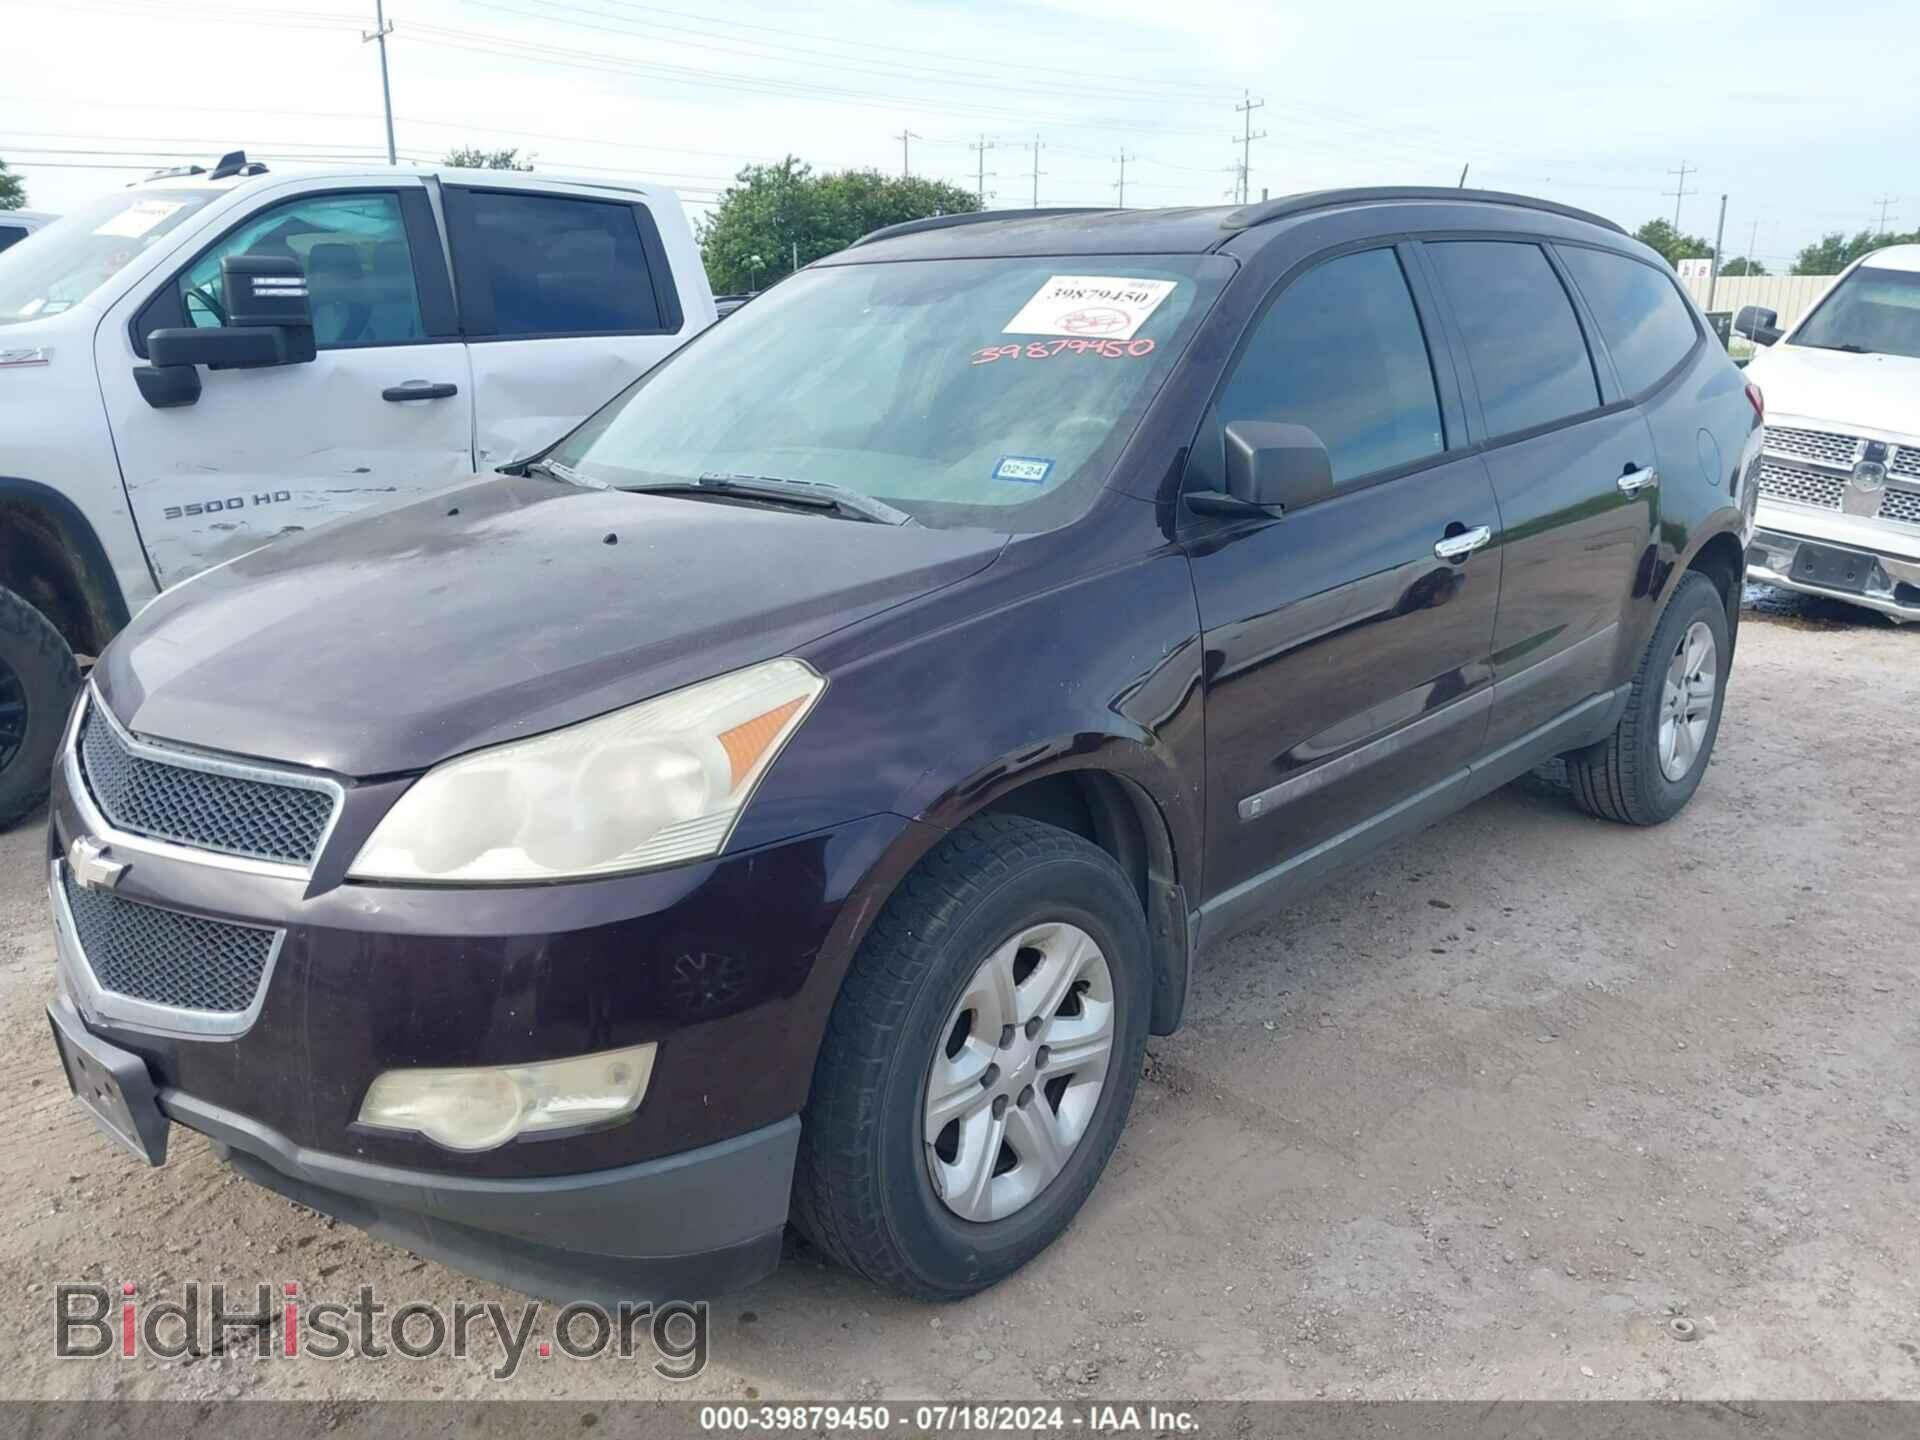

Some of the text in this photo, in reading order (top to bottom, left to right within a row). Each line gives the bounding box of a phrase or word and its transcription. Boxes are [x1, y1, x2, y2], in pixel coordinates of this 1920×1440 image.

[970, 338, 1156, 367] 39879450
[162, 490, 291, 520] 3500 HD
